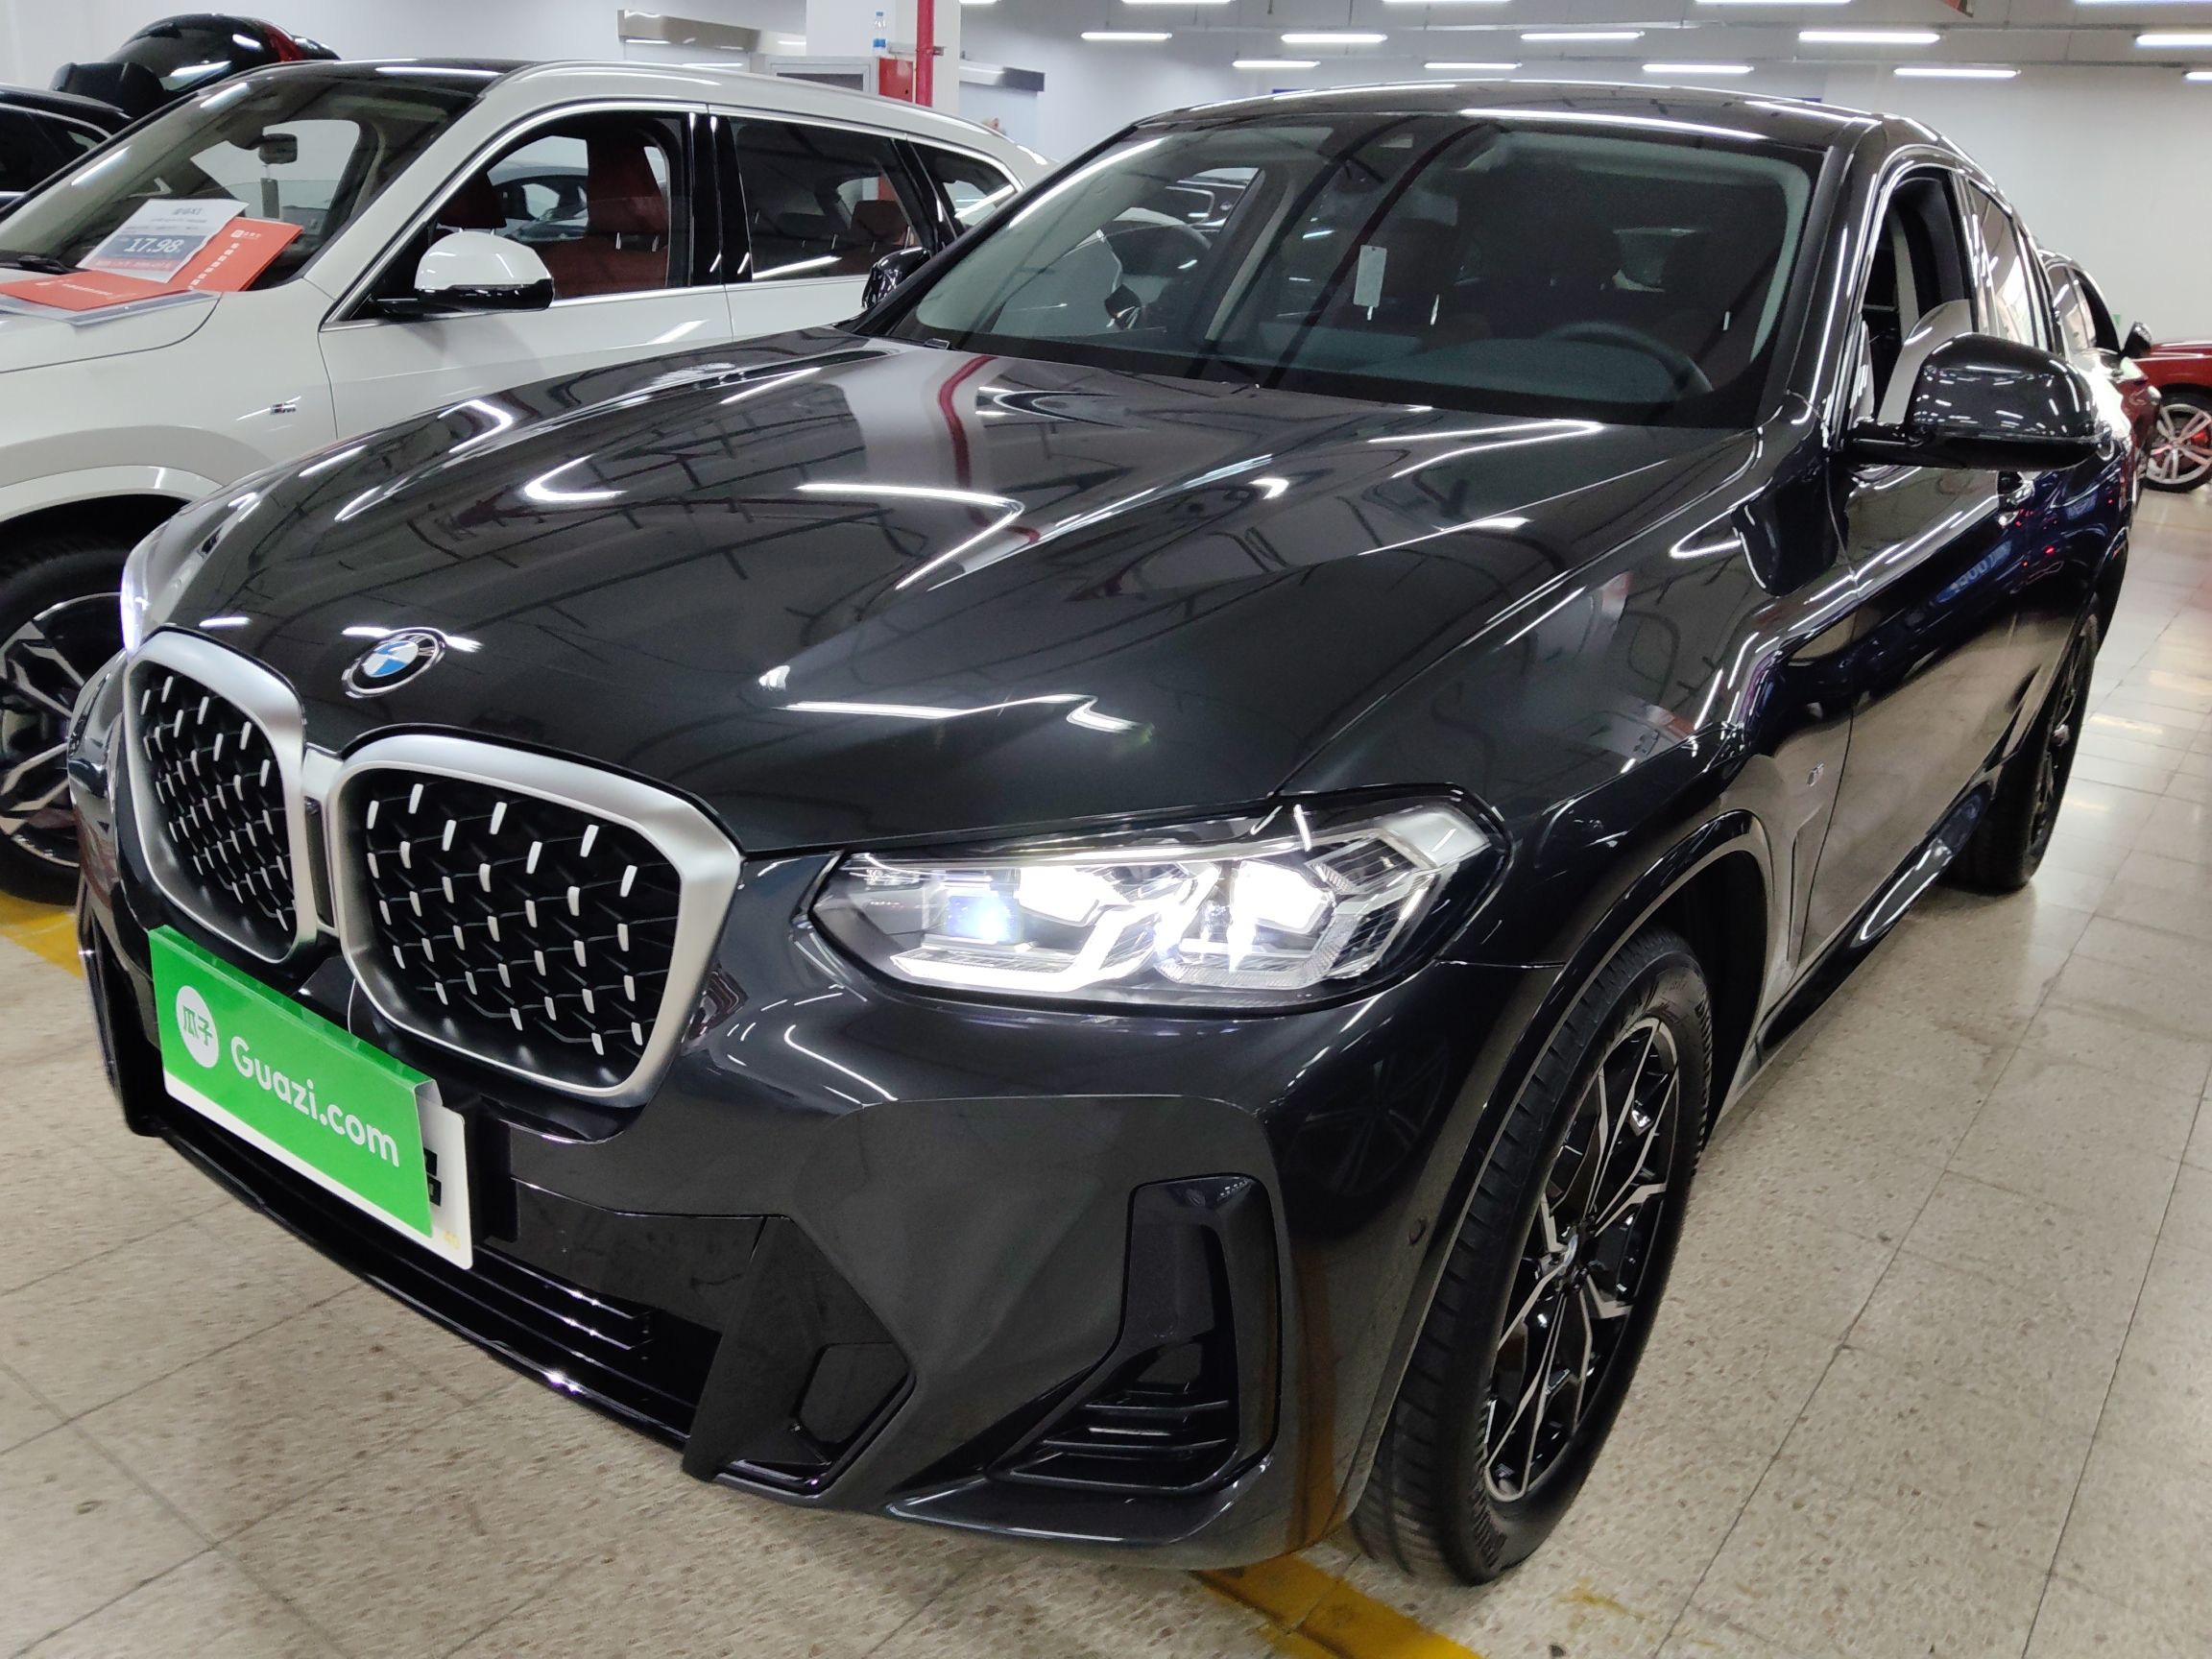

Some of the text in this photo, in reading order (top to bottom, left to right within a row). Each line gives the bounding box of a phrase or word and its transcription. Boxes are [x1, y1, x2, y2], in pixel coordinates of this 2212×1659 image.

[124, 237, 185, 253] 17.98
[181, 1005, 213, 1046] 瓜子
[230, 1036, 400, 1168] Guazi.com
